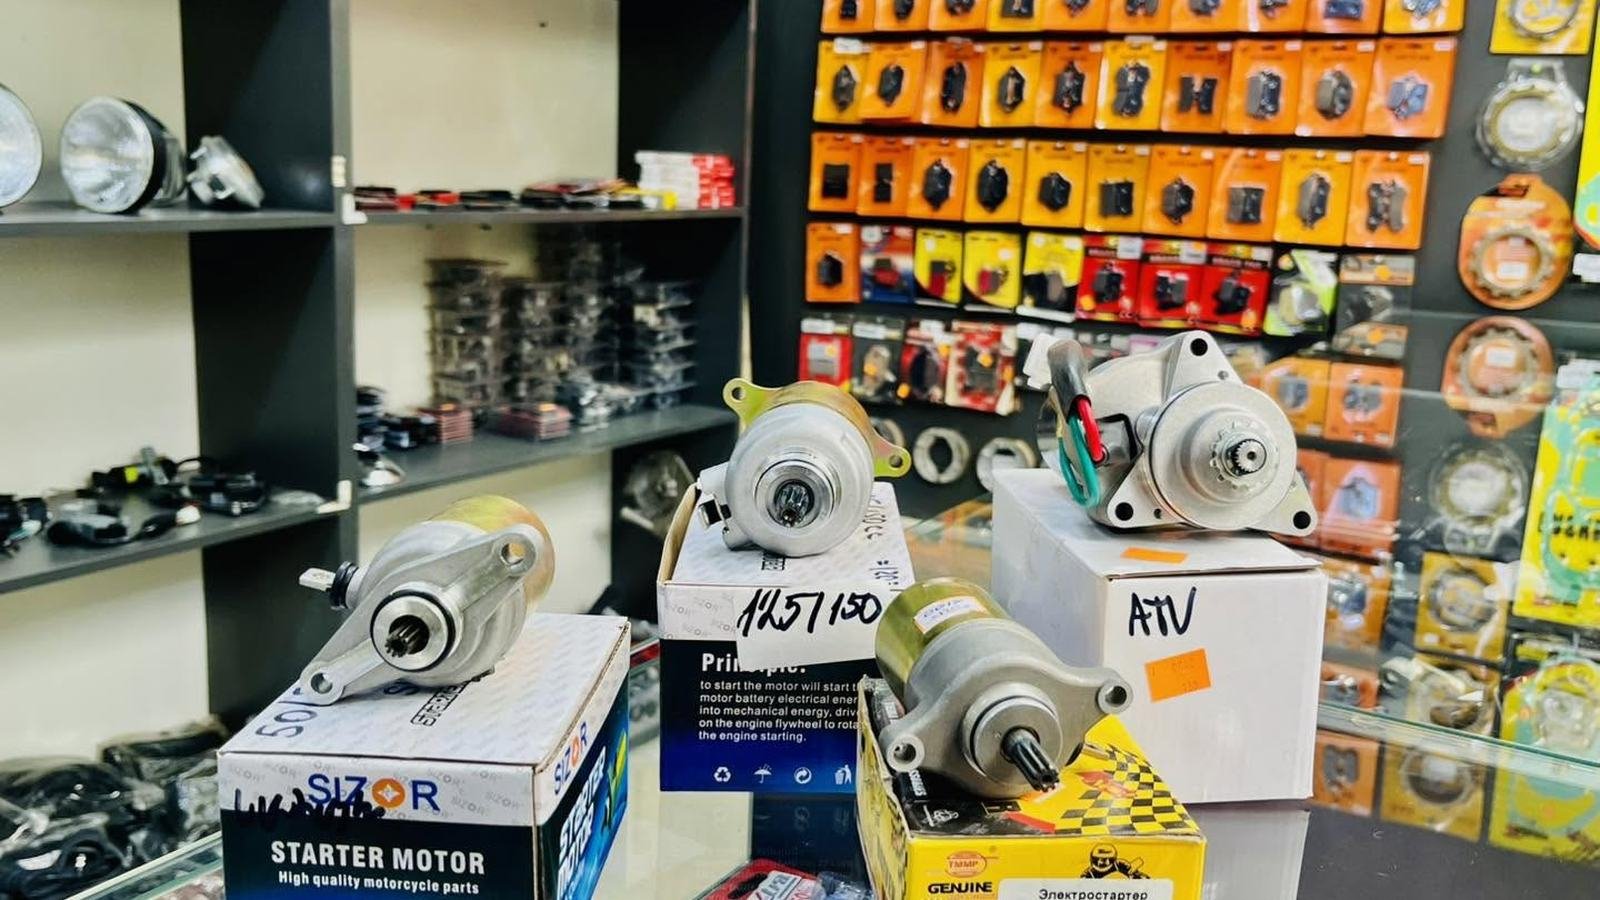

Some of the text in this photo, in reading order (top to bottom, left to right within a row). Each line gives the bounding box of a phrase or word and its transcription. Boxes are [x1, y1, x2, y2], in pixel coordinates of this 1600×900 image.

[1129, 586, 1197, 636] ATV
[700, 681, 712, 690] to
[714, 681, 741, 690] start
[744, 681, 762, 691] the
[765, 682, 799, 691] motor
[801, 682, 820, 691] will
[823, 683, 849, 692] start
[700, 692, 858, 705] motor battery electrical ener
[699, 705, 857, 719] into mechanical energy, driv
[698, 718, 861, 731] on the engine flywheel to rota
[699, 730, 807, 744] the engine starting.
[271, 840, 485, 875] STARTER MOTOR
[278, 870, 480, 895] High quality motorcycle parts
[927, 881, 993, 895] GENUINE
